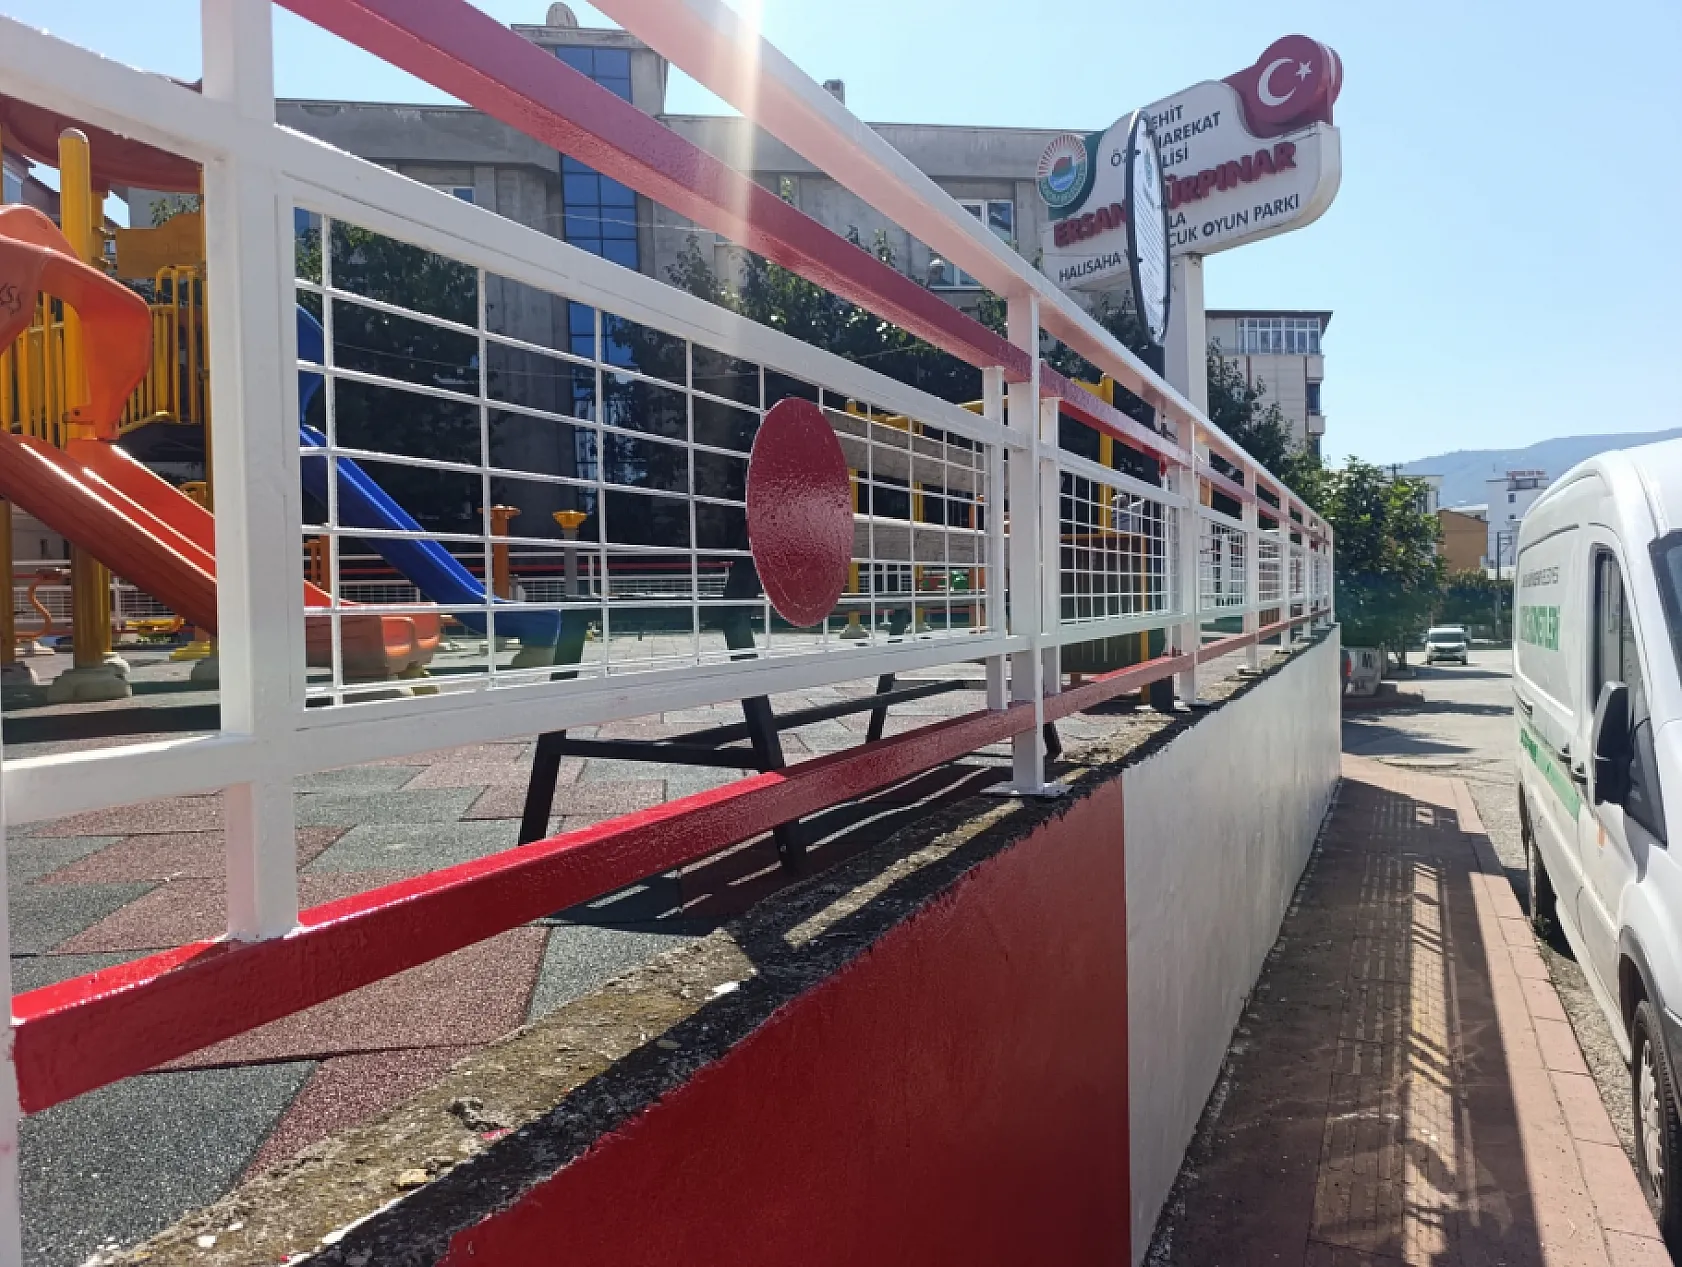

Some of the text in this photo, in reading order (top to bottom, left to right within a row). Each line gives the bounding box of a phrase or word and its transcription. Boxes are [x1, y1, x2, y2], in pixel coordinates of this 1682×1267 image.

[1151, 104, 1184, 130] EHİT
[1161, 141, 1189, 168] LİSİ
[1054, 141, 1297, 248] ERSAN ÜRPINAR
[1058, 192, 1299, 281] HALISAHA CUK OYUN PARKI
